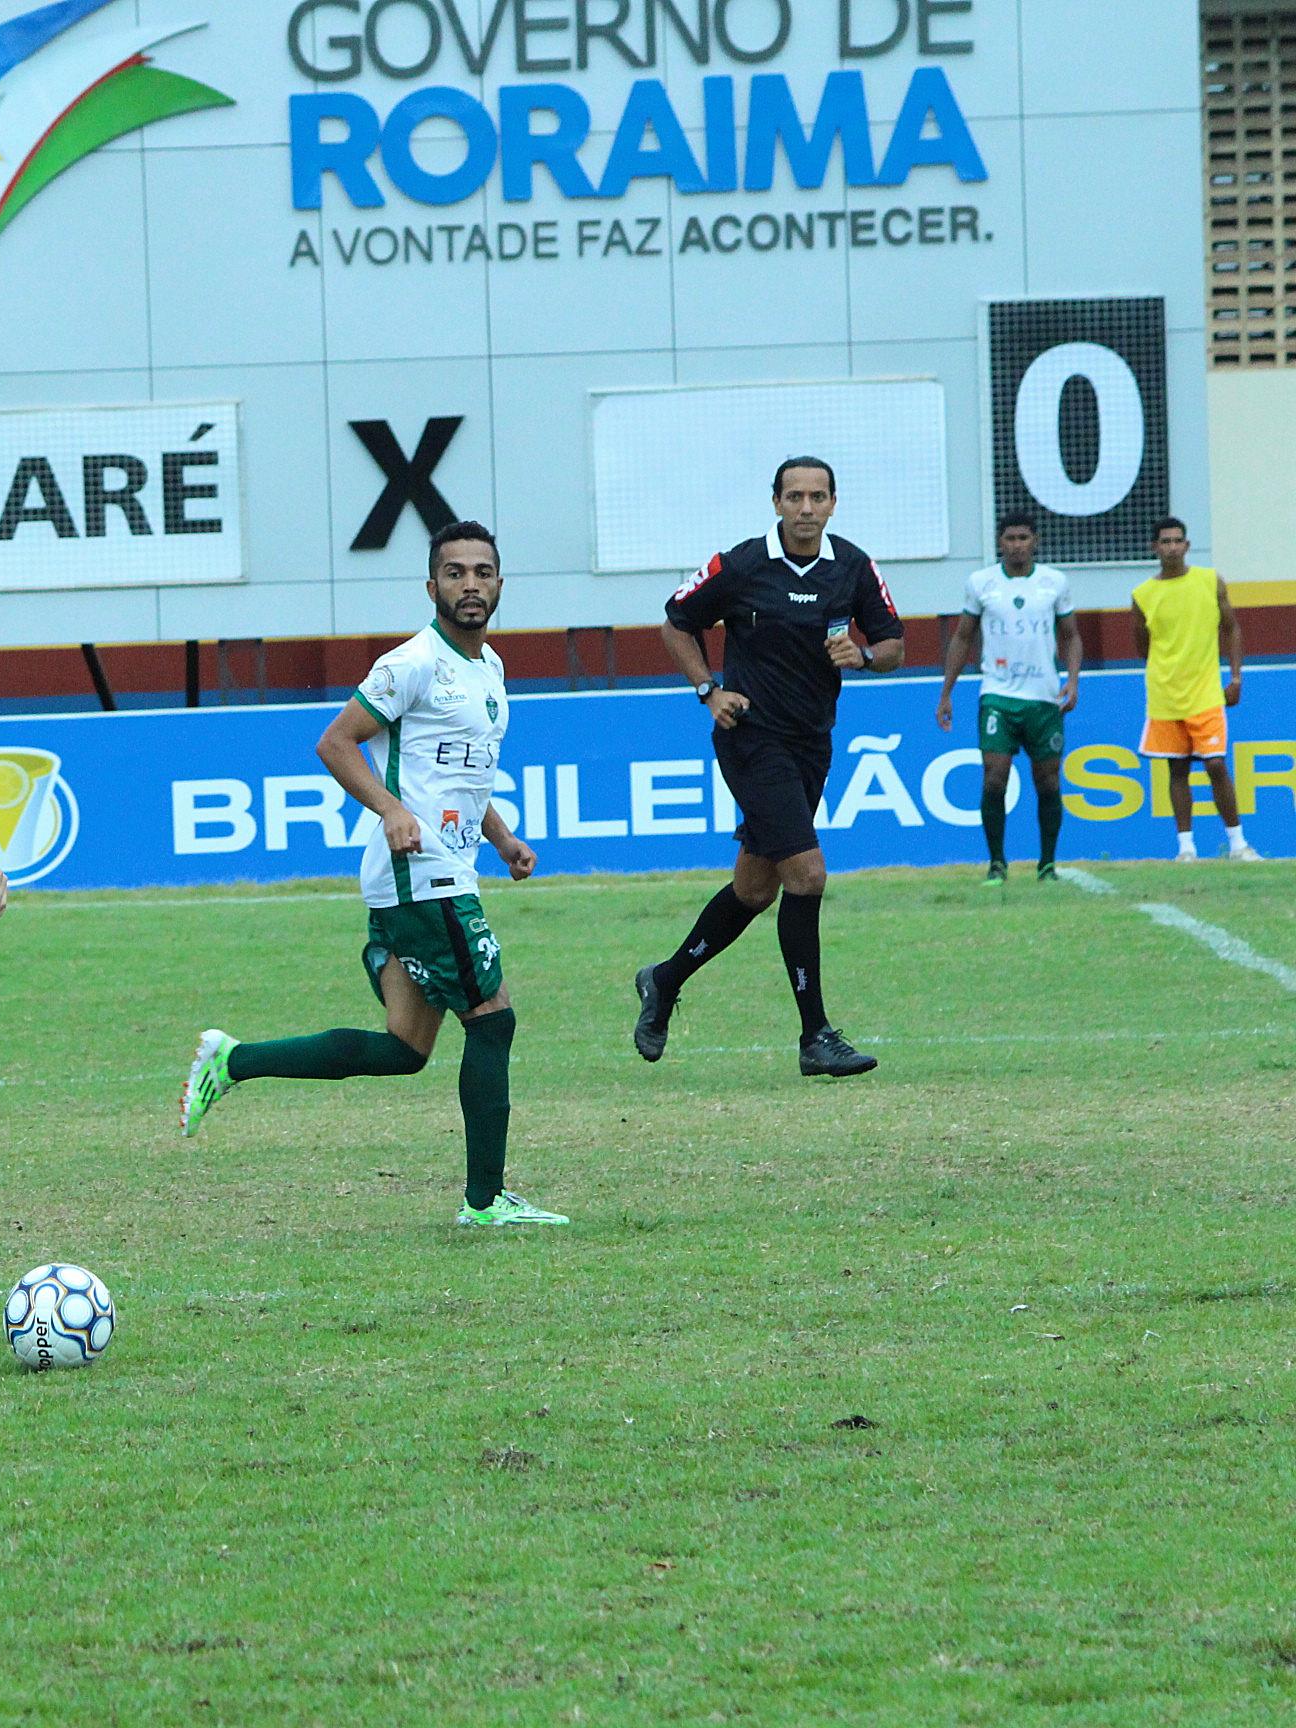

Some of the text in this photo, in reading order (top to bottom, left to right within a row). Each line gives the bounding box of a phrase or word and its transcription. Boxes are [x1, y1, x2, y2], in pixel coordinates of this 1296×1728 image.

[287, 0, 975, 82] GOVERNO DE
[289, 67, 989, 212] RORAIMA
[290, 205, 994, 267] A VONTADE FAZ ACONTECER.
